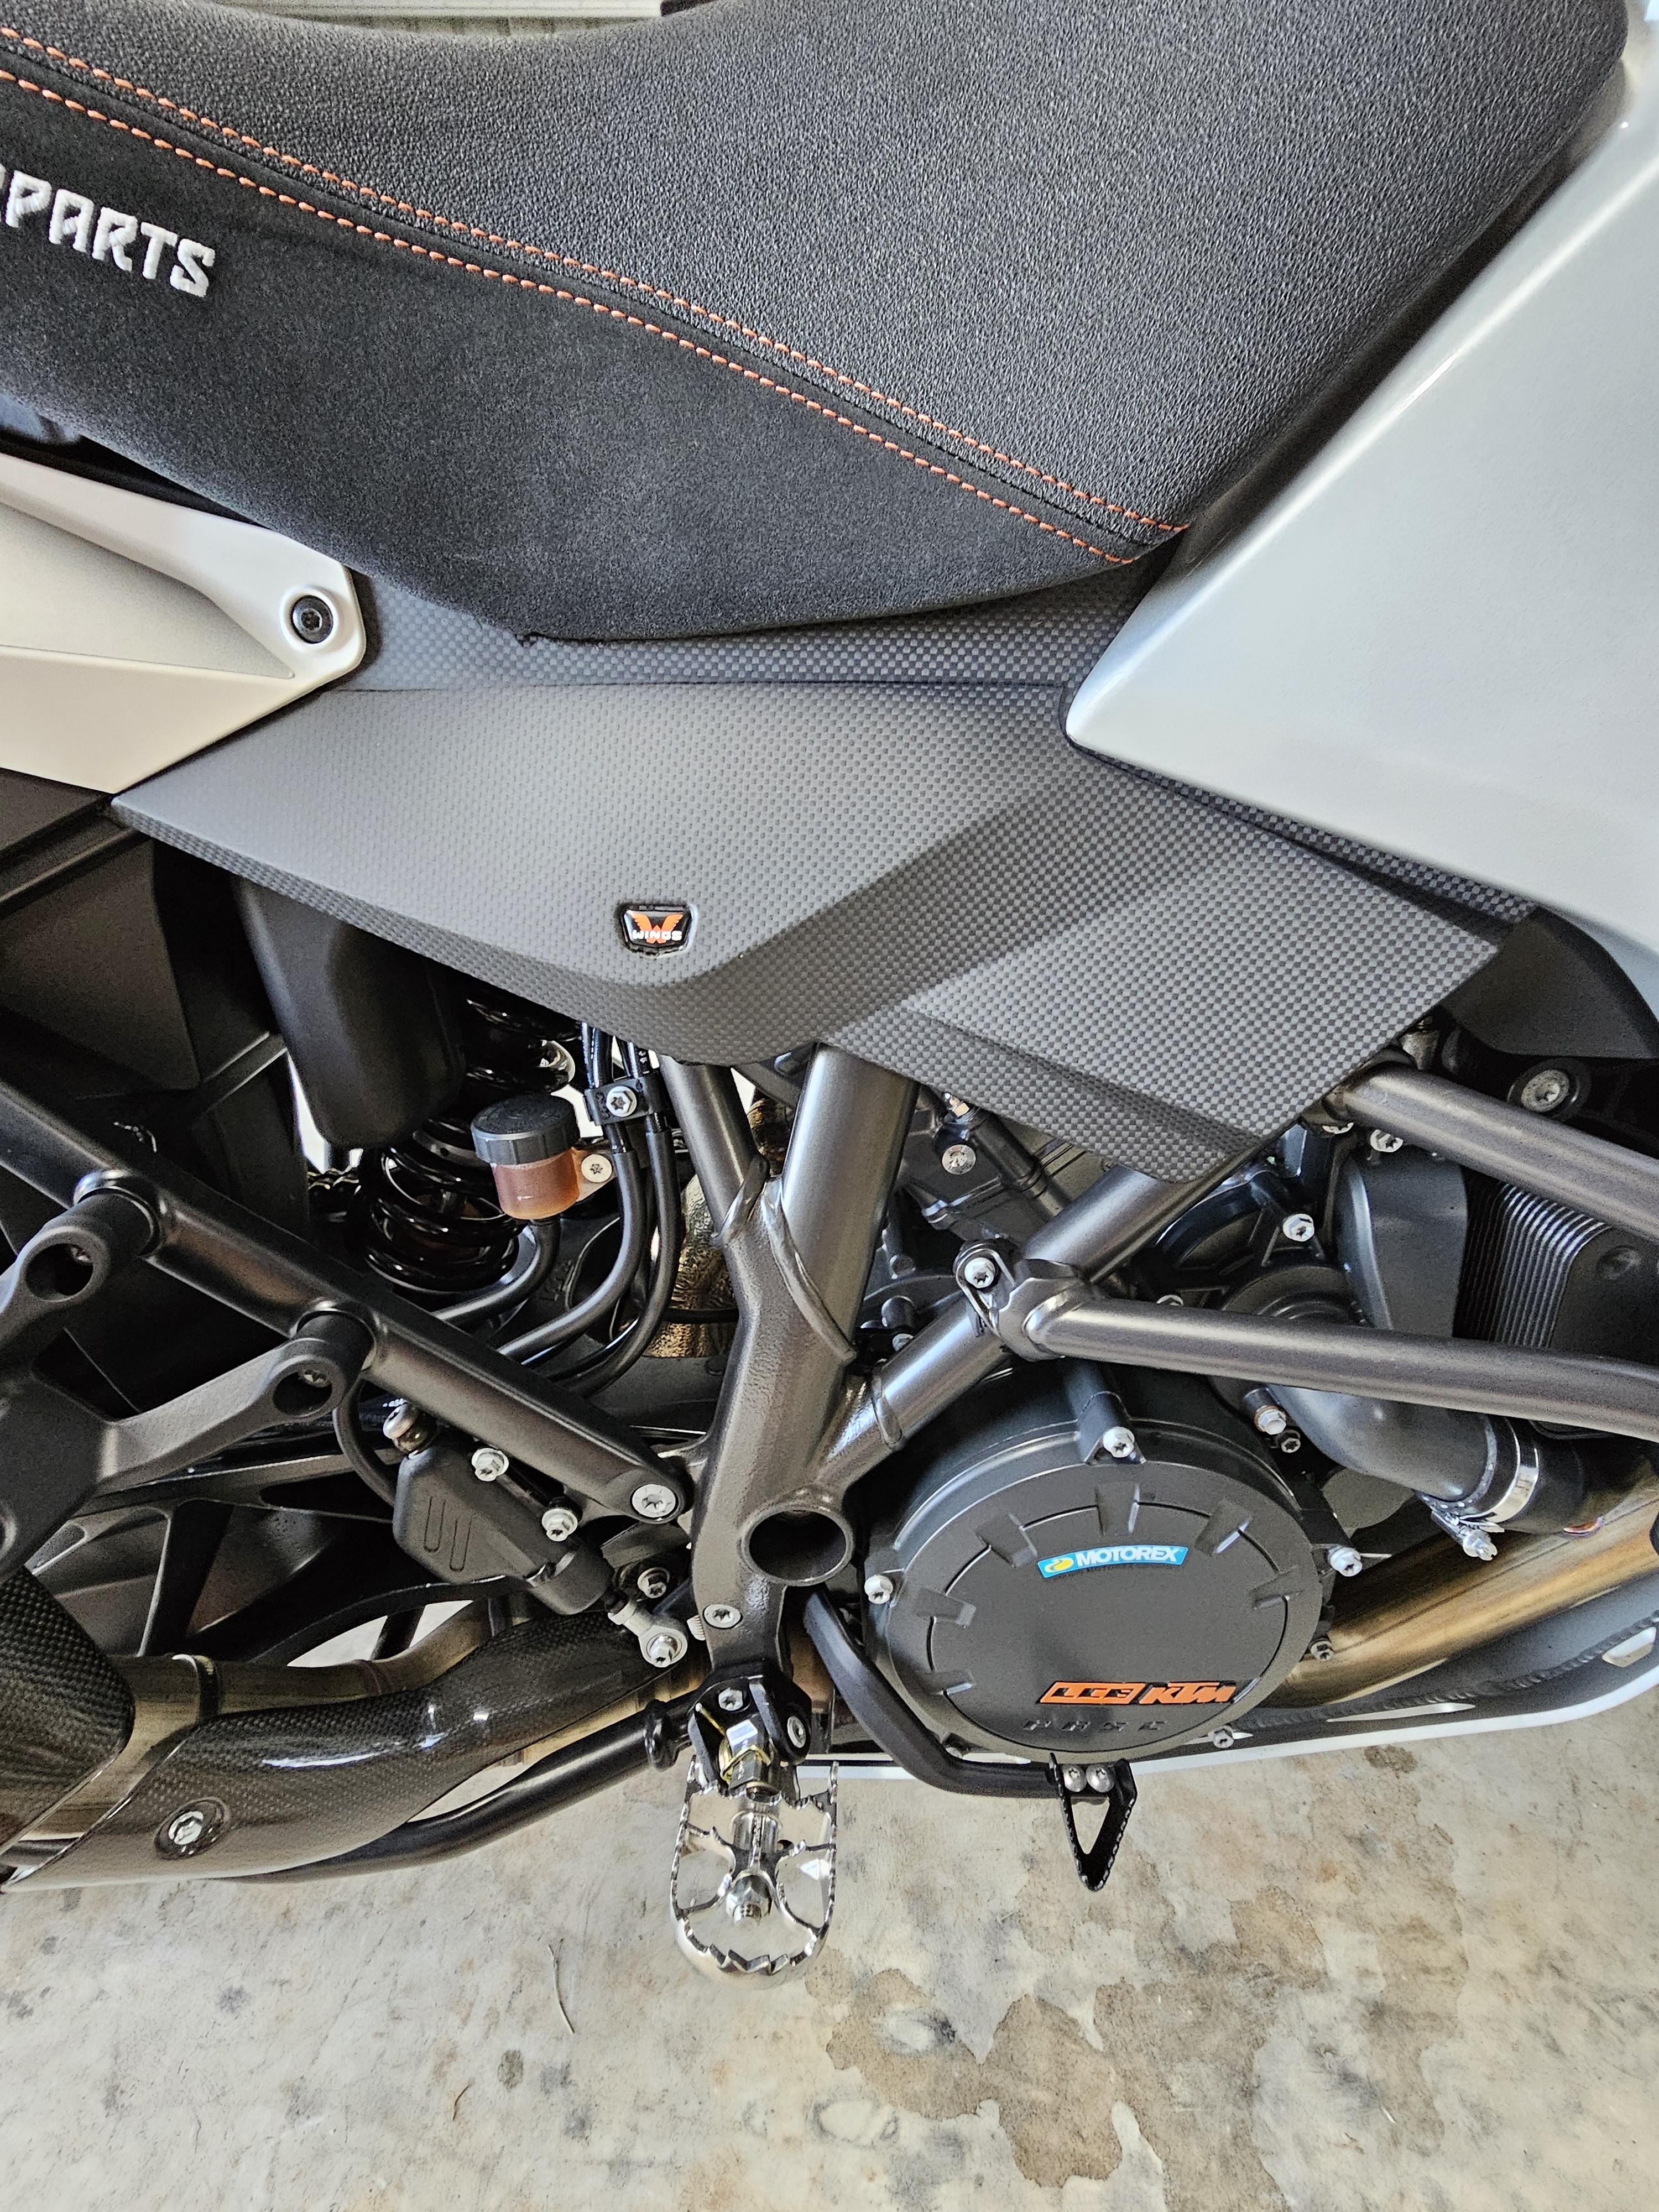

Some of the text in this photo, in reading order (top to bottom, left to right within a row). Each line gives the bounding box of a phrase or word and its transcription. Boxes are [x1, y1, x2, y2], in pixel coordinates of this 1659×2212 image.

[0, 164, 216, 298] PARTS
[632, 930, 683, 941] WINGS
[1074, 1546, 1181, 1567] MOTOREX
[1139, 1682, 1237, 1704] KTM
